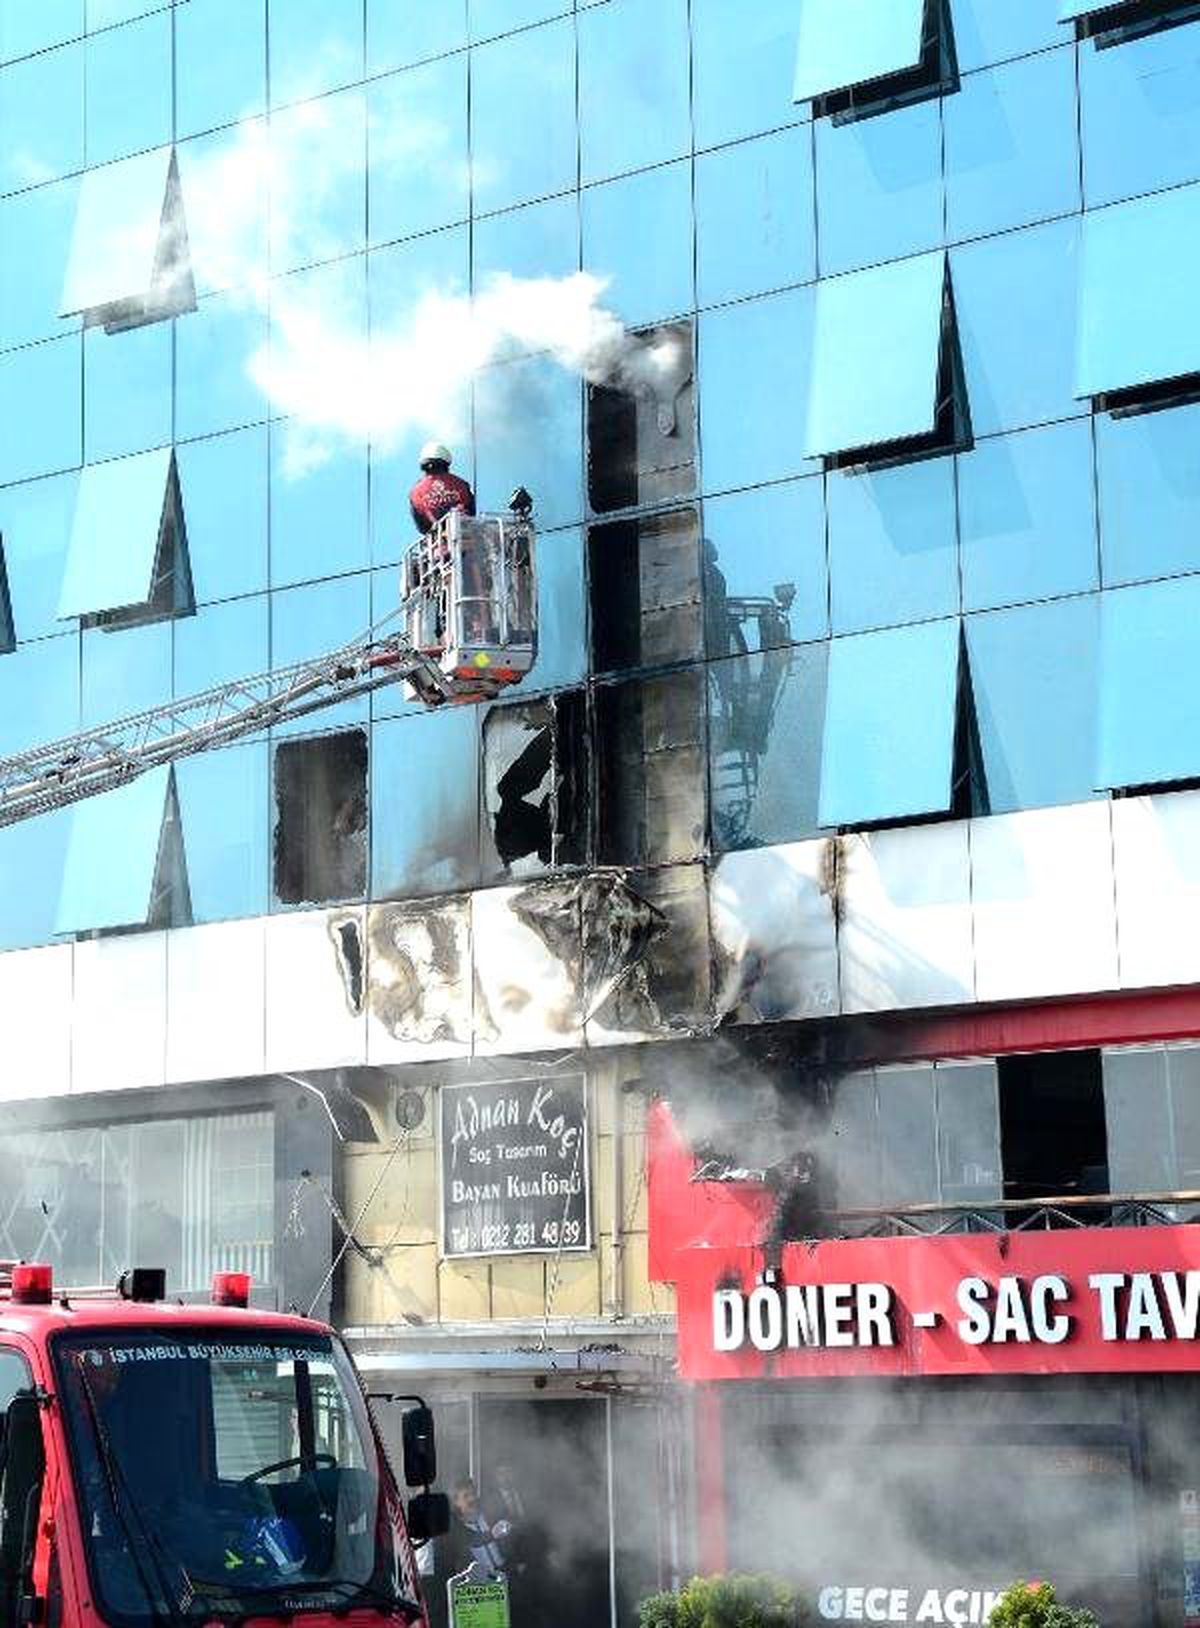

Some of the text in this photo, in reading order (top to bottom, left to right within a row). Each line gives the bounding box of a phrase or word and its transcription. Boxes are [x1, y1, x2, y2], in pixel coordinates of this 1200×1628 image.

[713, 1268, 895, 1352] DÖNER
[957, 1275, 1070, 1345] SAC
[109, 1346, 187, 1364] İSTANBUL
[818, 1585, 909, 1621] GECE
